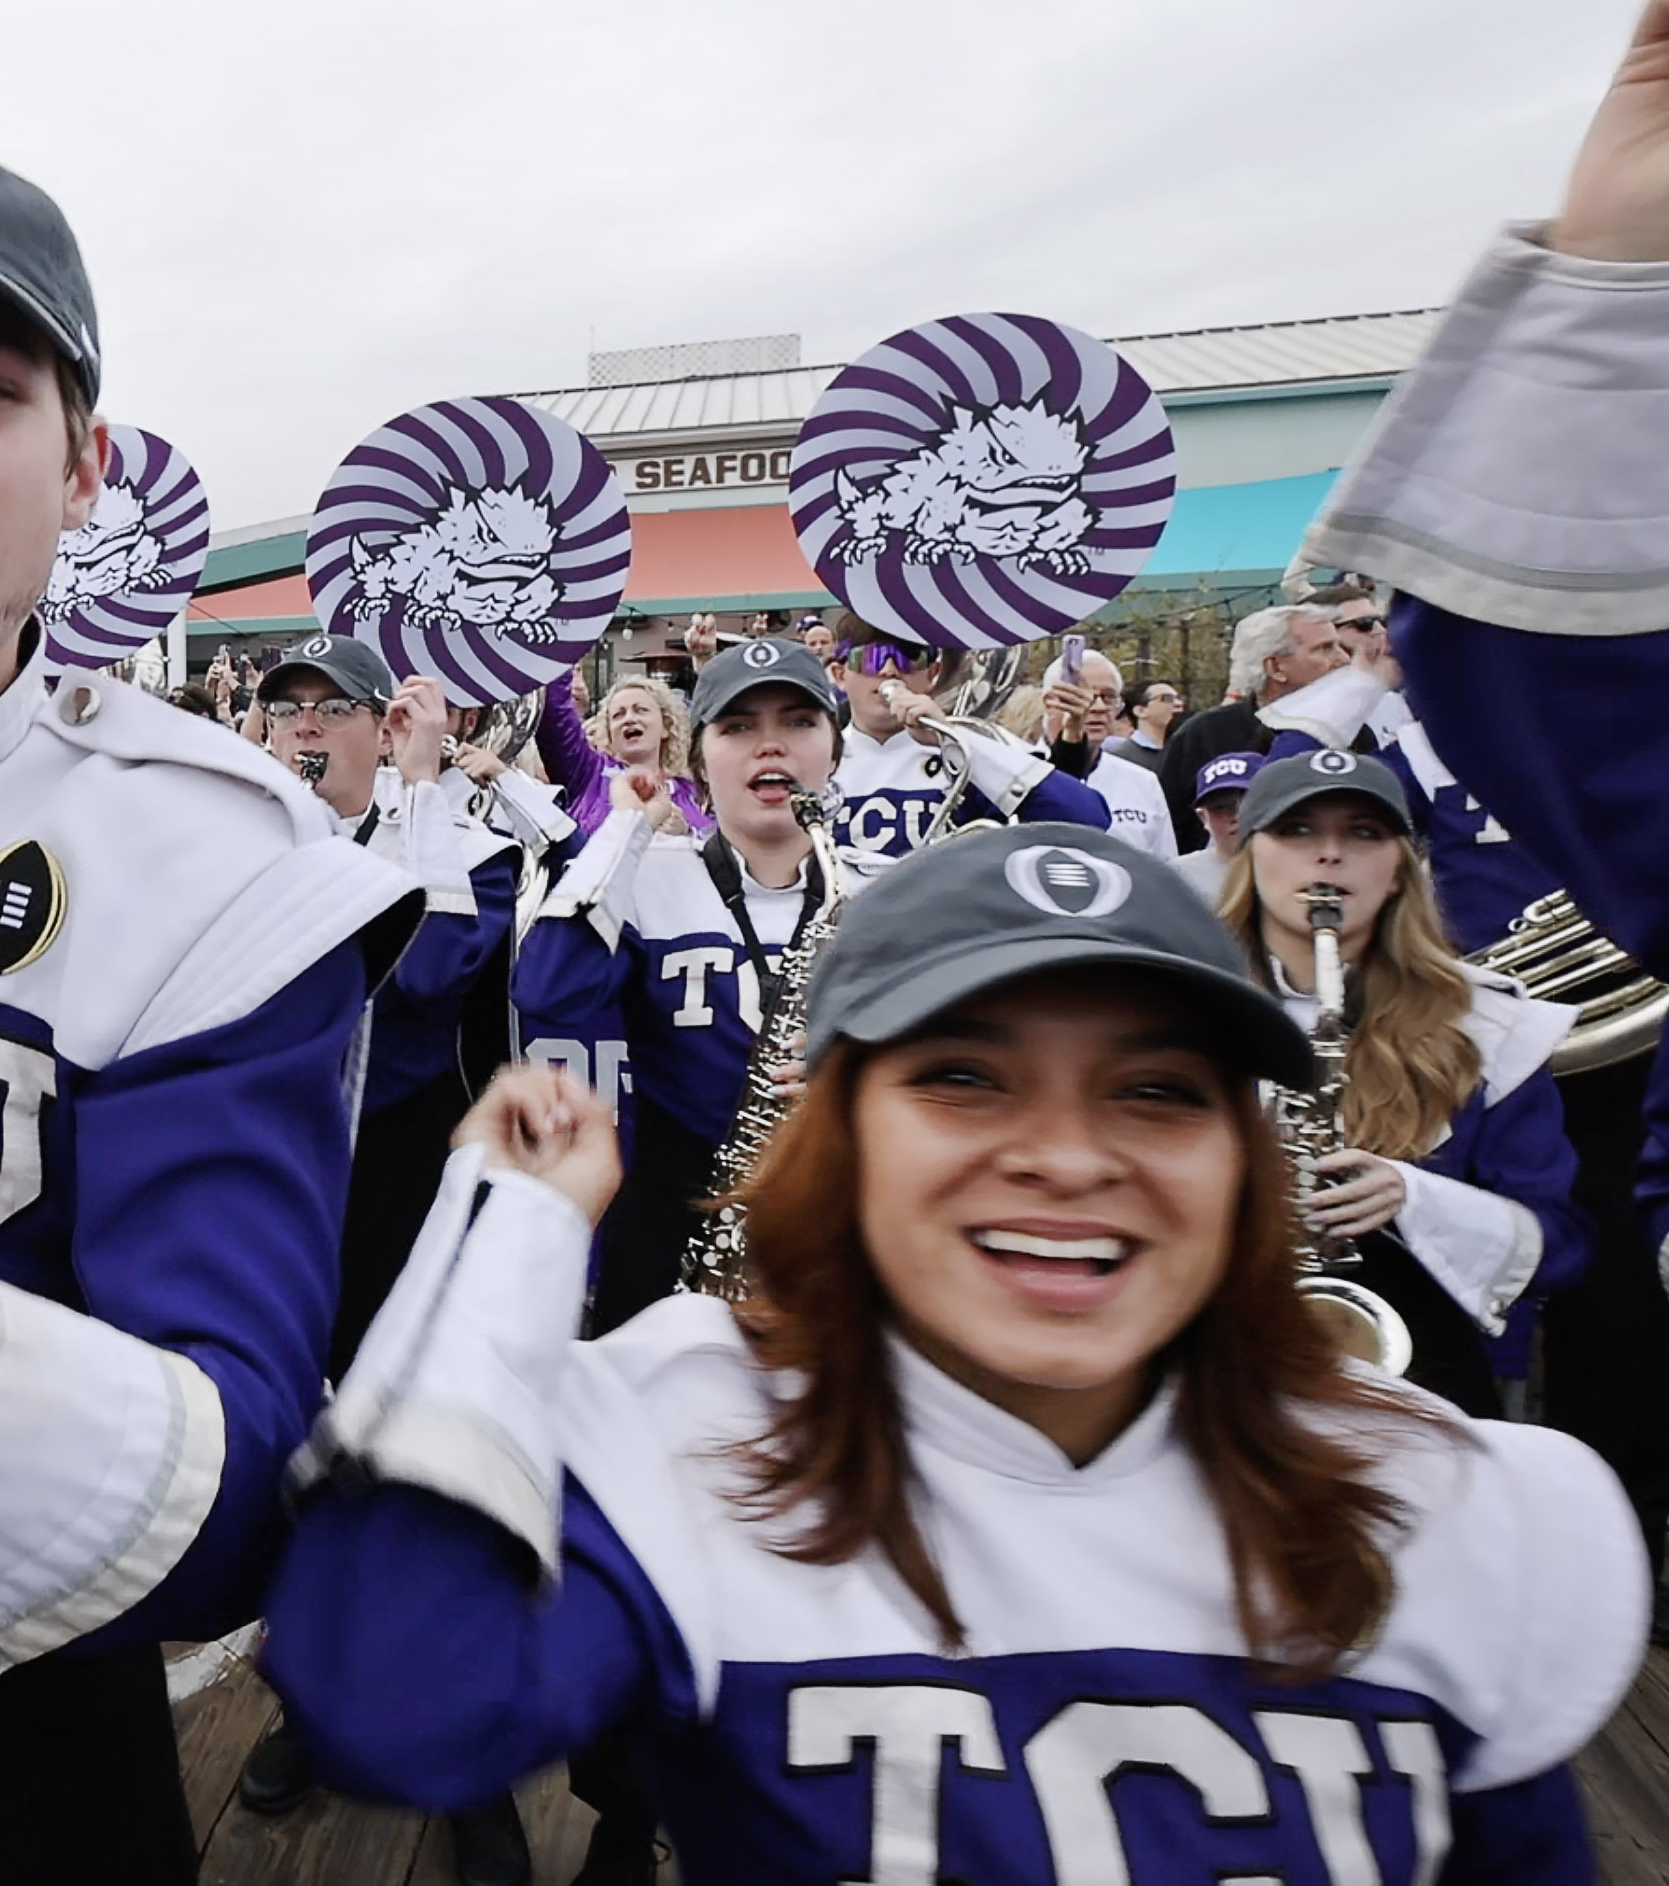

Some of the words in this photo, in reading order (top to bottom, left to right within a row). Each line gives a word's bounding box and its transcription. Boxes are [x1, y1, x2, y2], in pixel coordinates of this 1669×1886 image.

[1204, 759, 1248, 784] TCU
[1113, 808, 1148, 824] TCU
[787, 1685, 1454, 1886] TCU
